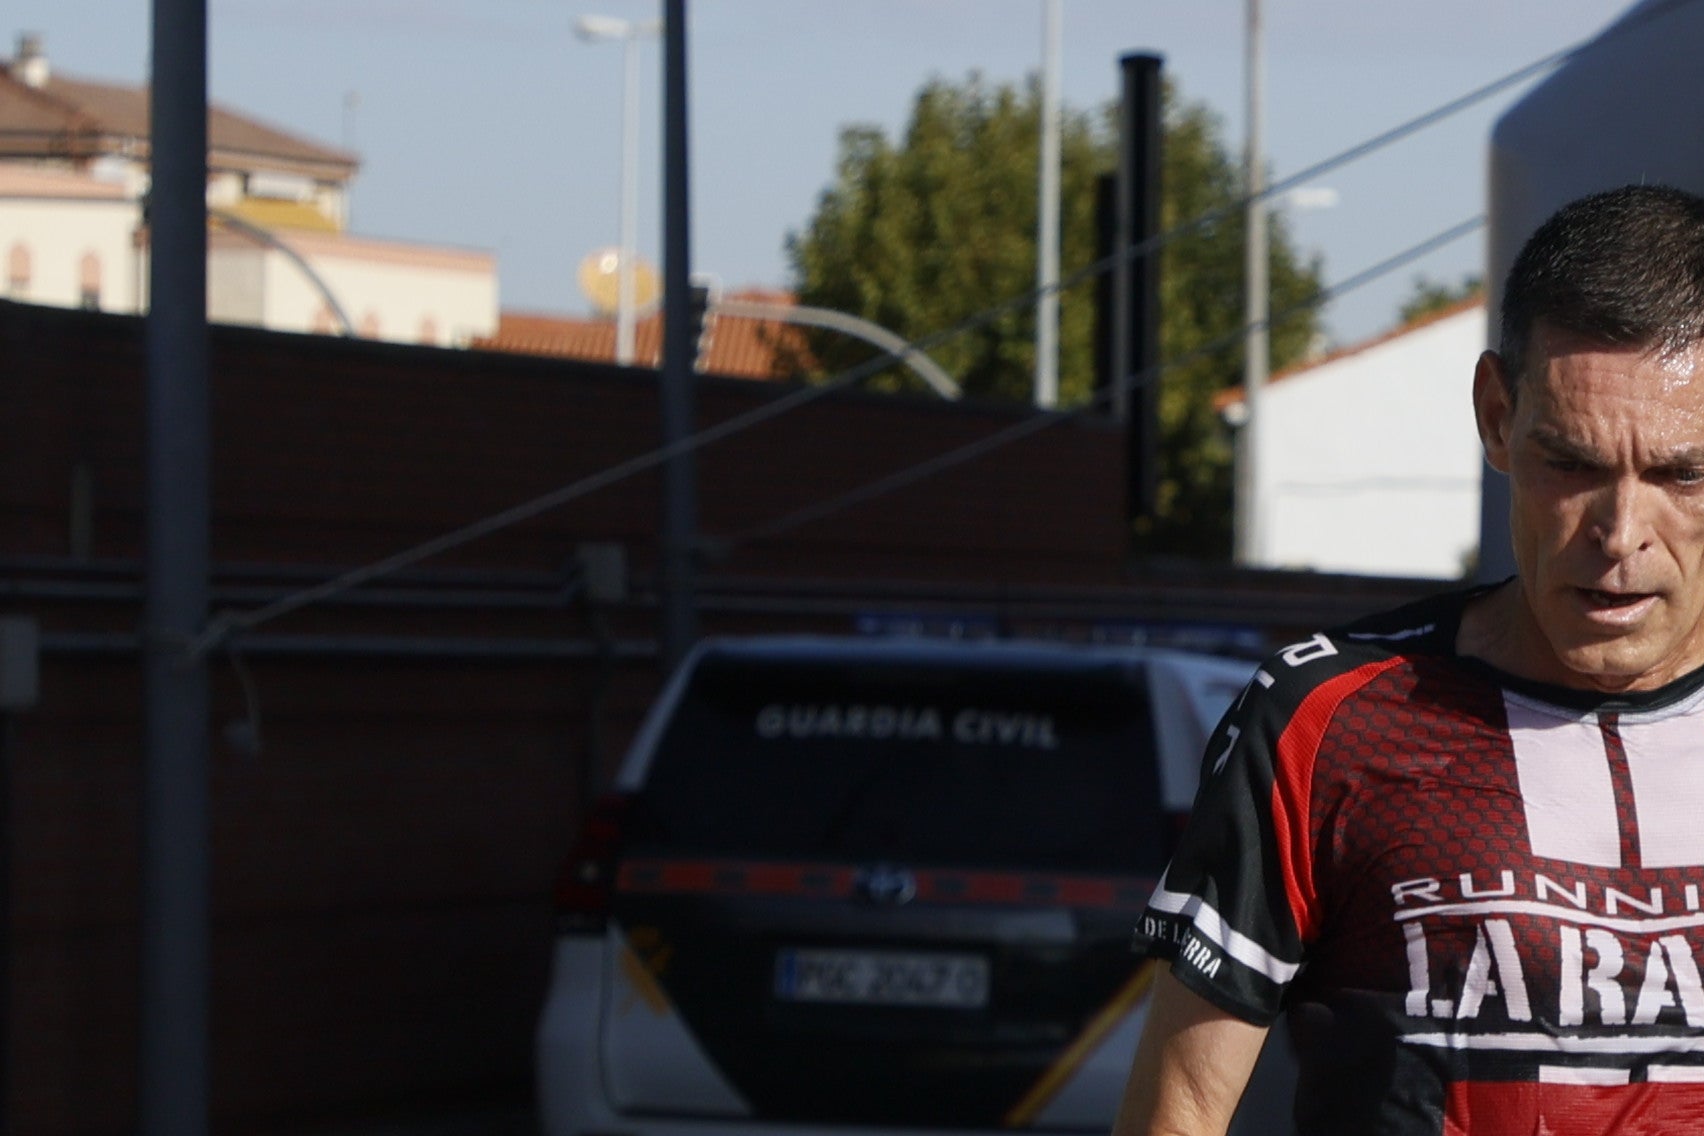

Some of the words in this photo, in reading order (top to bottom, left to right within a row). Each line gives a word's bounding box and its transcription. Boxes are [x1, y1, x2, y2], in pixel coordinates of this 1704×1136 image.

[755, 703, 943, 740] GUARDIA
[951, 708, 1061, 750] CIVIL
[1144, 916, 1167, 940] DE
[1403, 918, 1533, 1022] LA
